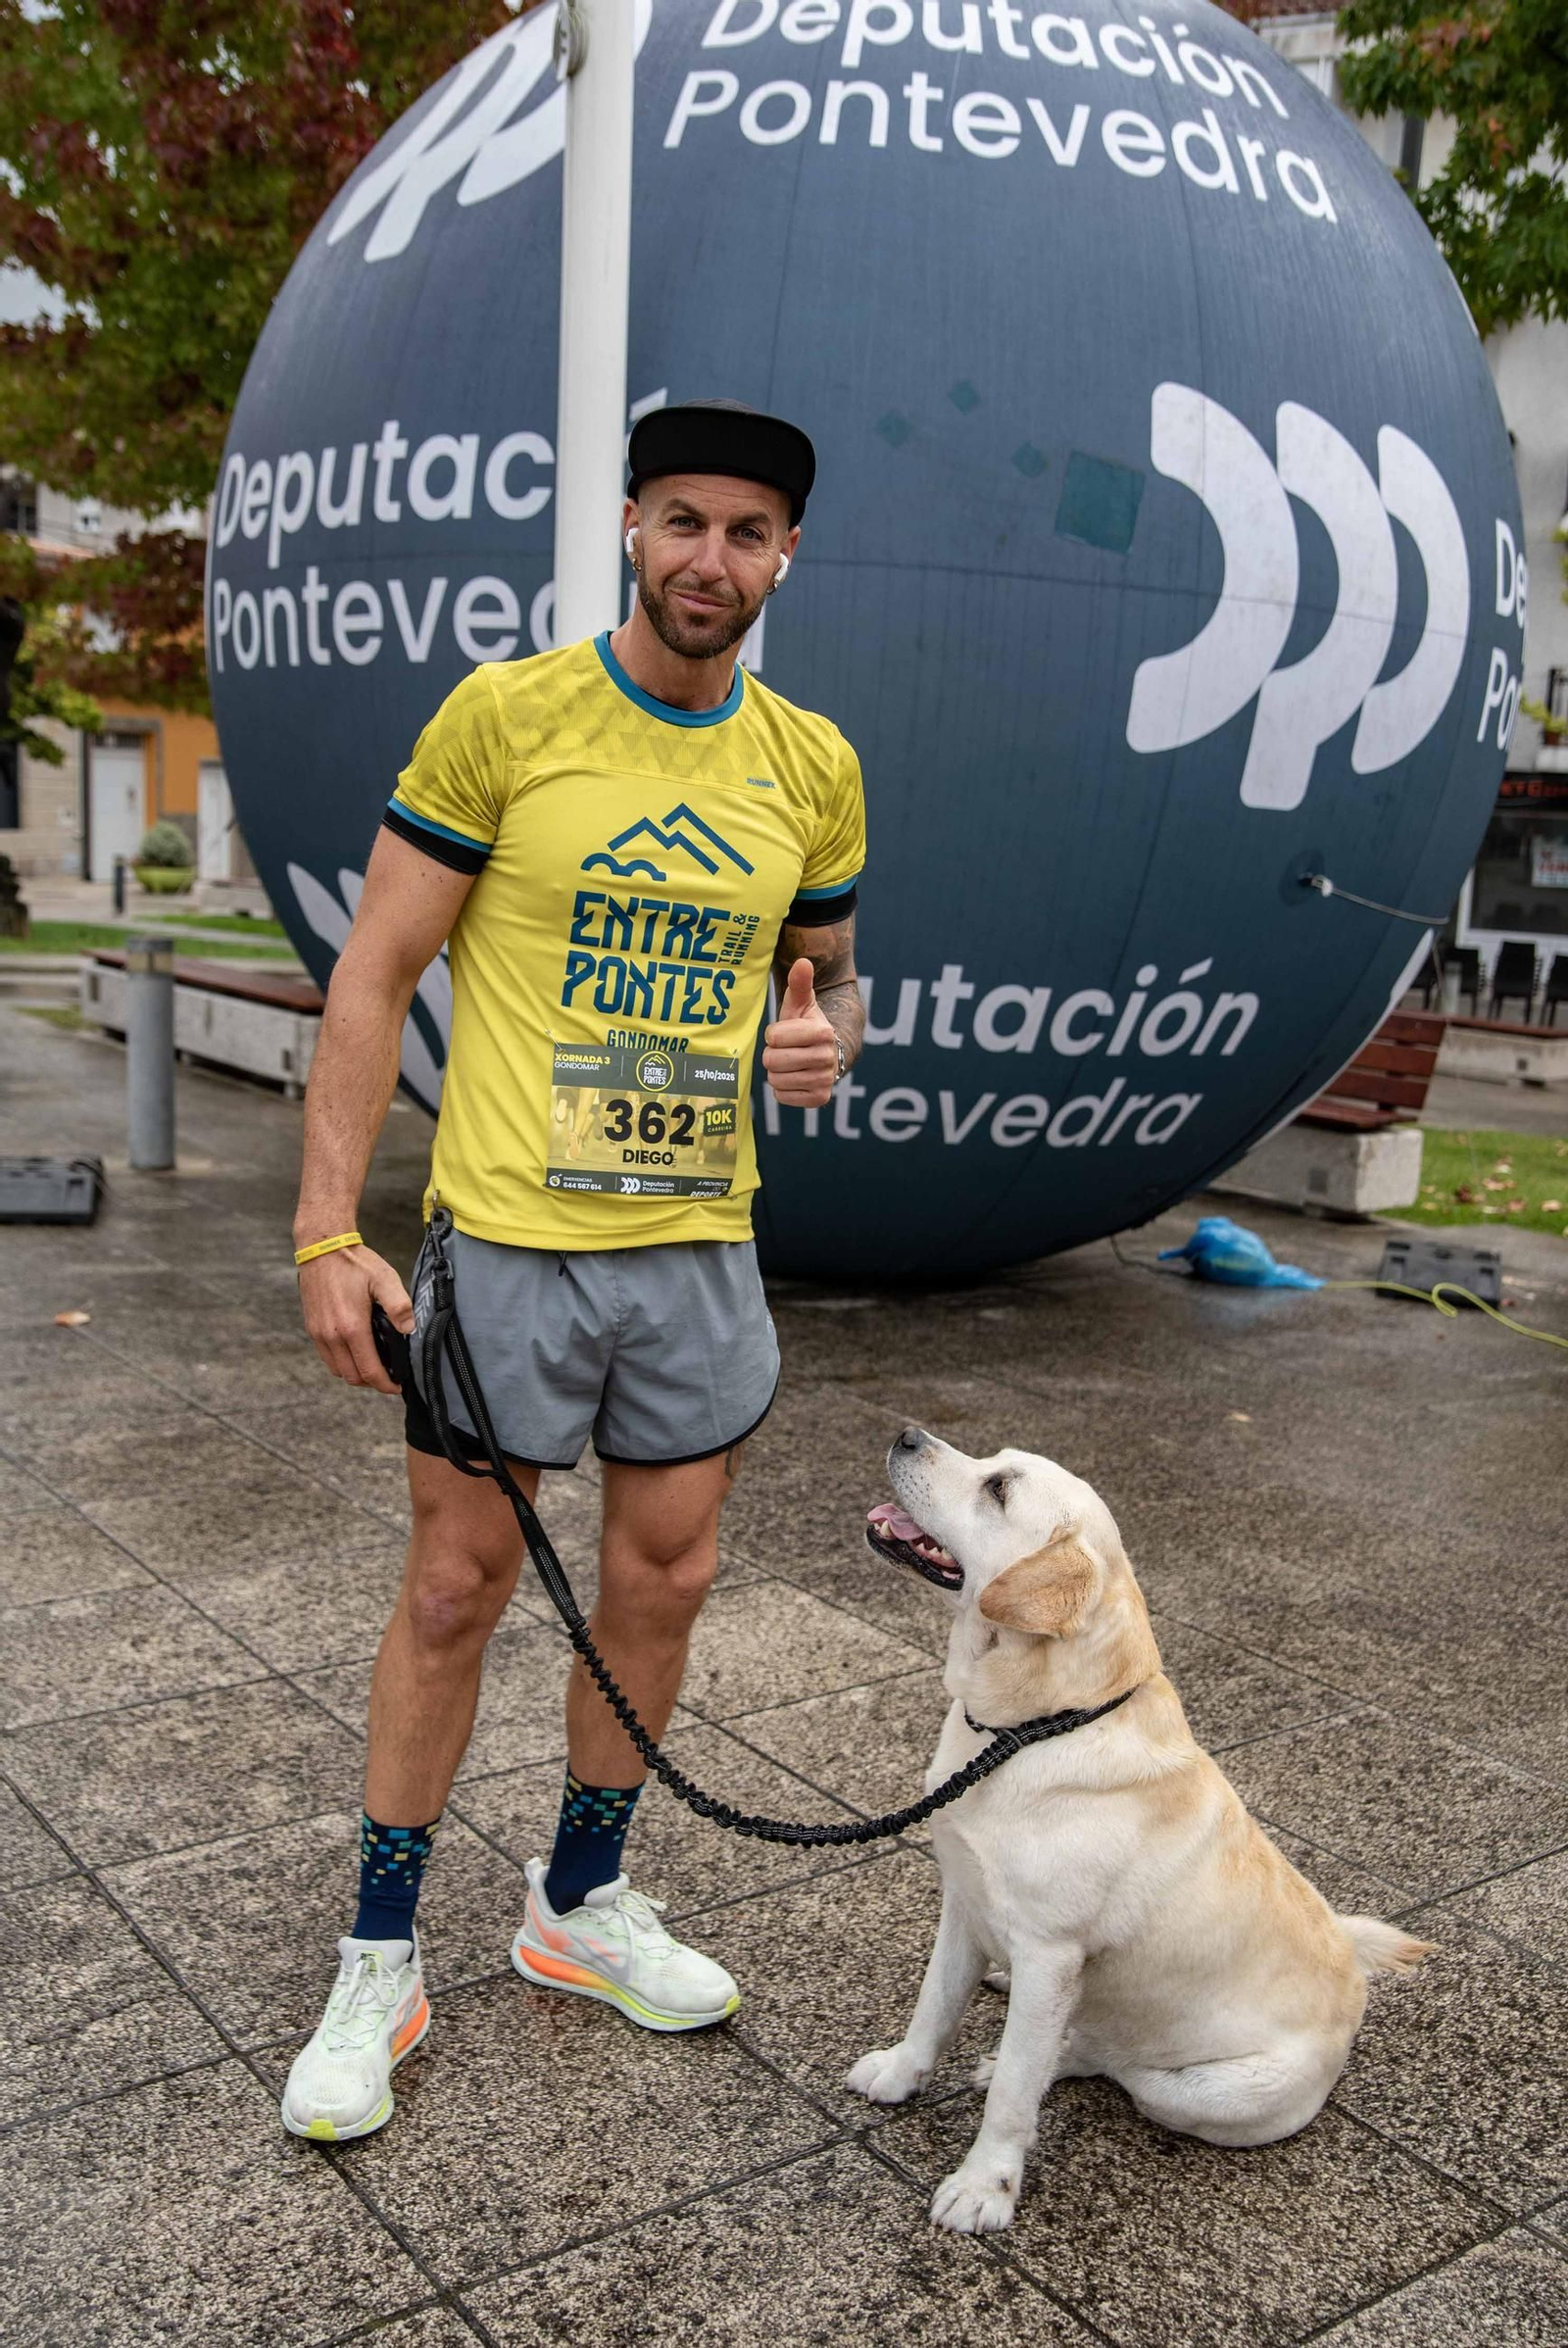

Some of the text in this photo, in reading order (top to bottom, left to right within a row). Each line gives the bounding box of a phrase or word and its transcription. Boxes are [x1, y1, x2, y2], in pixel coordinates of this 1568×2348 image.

[701, 0, 1291, 120] Deputación
[662, 70, 1339, 223] Pontevedra
[216, 419, 556, 570] Deputac
[213, 565, 556, 674] Ponteve
[569, 890, 732, 963] ENTRE
[717, 913, 747, 963] TRAIL &
[730, 915, 760, 965] RUNNING
[561, 950, 736, 1025] PONTES
[856, 956, 1260, 1057] utación
[554, 1061, 600, 1071] GONDOMAR
[555, 1053, 611, 1065] XORNADA 3
[607, 1028, 690, 1053] GONDOMAR
[604, 1099, 696, 1146] 362
[706, 1108, 732, 1126] 10K
[762, 1078, 1203, 1148] ntevedra
[622, 1149, 673, 1165] DIEGO
